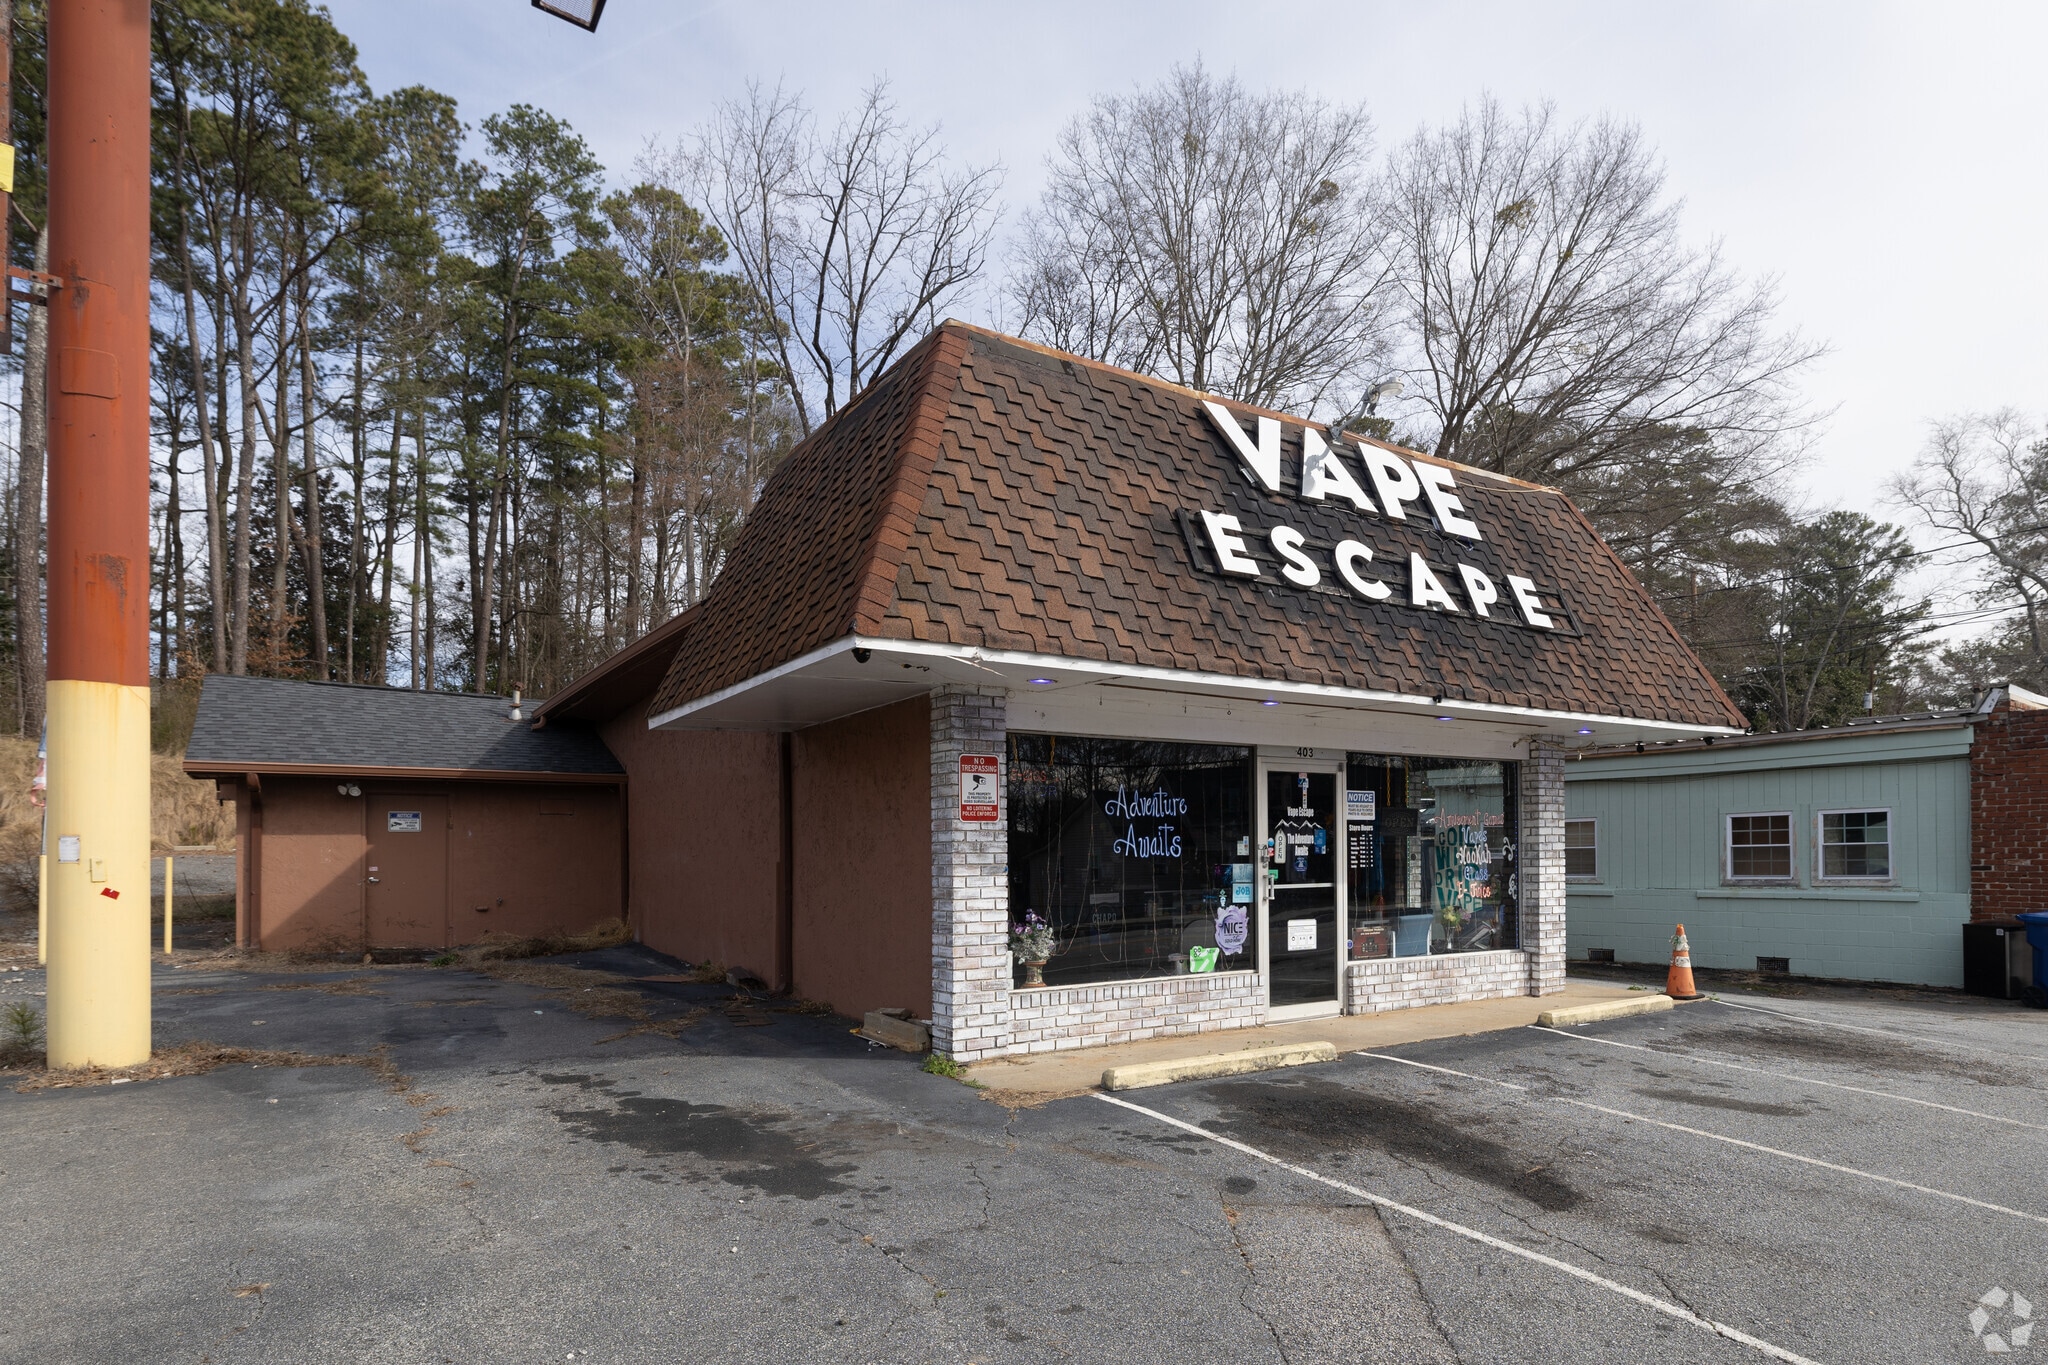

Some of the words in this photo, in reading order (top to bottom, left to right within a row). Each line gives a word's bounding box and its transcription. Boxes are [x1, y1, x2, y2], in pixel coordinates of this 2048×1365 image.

[1201, 400, 1483, 541] VAPE
[1200, 509, 1555, 630] ESCAPE
[1297, 747, 1314, 758] 403
[973, 757, 985, 765] NO
[962, 765, 998, 773] TRESPASSING
[1105, 783, 1187, 819] Adventure
[1348, 793, 1374, 802] NOTICE
[1287, 806, 1298, 817] Vape
[1299, 806, 1314, 817] Escape
[1434, 808, 1481, 828] Amusement
[1114, 823, 1182, 858] Awaits
[1294, 833, 1314, 844] Adventure
[1462, 826, 1488, 846] Vapes
[1236, 886, 1251, 896] JOB
[1436, 887, 1483, 912] VAPE
[1093, 912, 1117, 923] CHAPO
[1224, 922, 1243, 934] NICE
